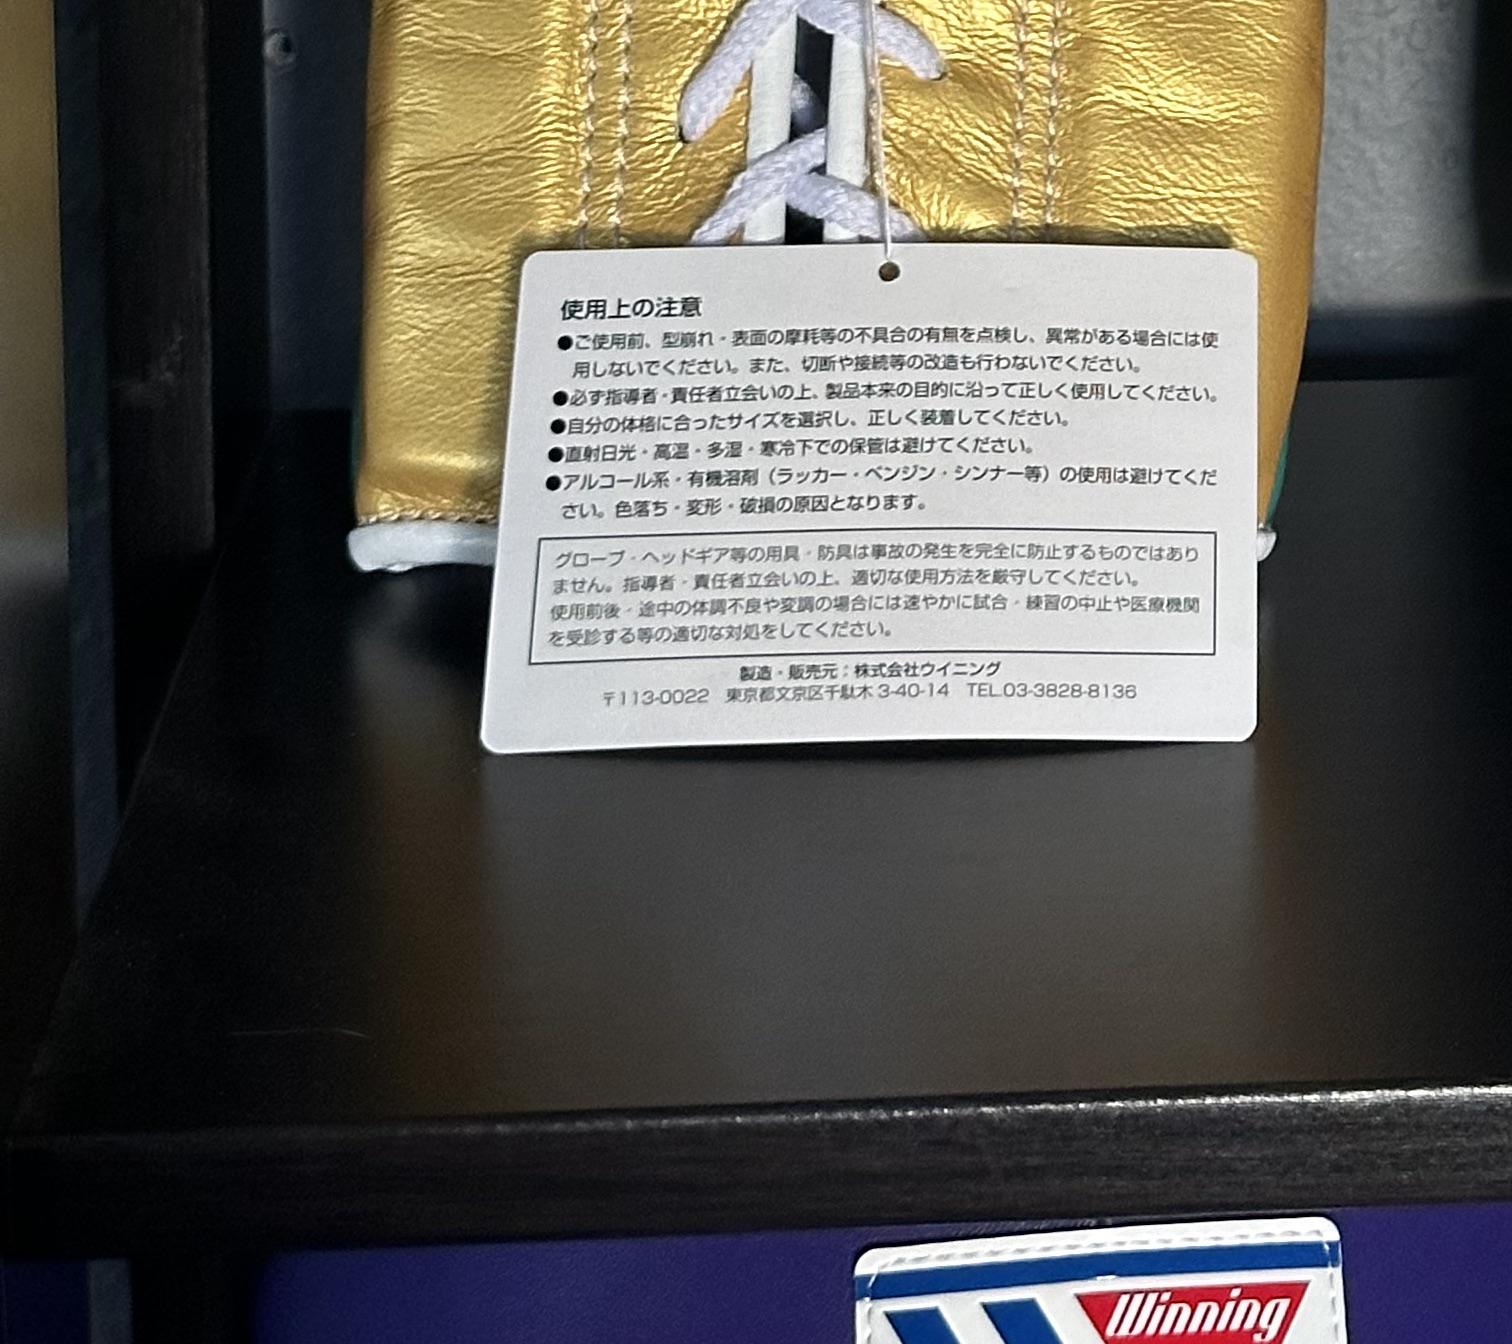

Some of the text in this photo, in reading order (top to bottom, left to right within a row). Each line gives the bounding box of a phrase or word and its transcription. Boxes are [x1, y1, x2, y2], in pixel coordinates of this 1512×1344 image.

[560, 296, 703, 321] 使用上の注意
[1106, 1288, 1291, 1342] Winning
